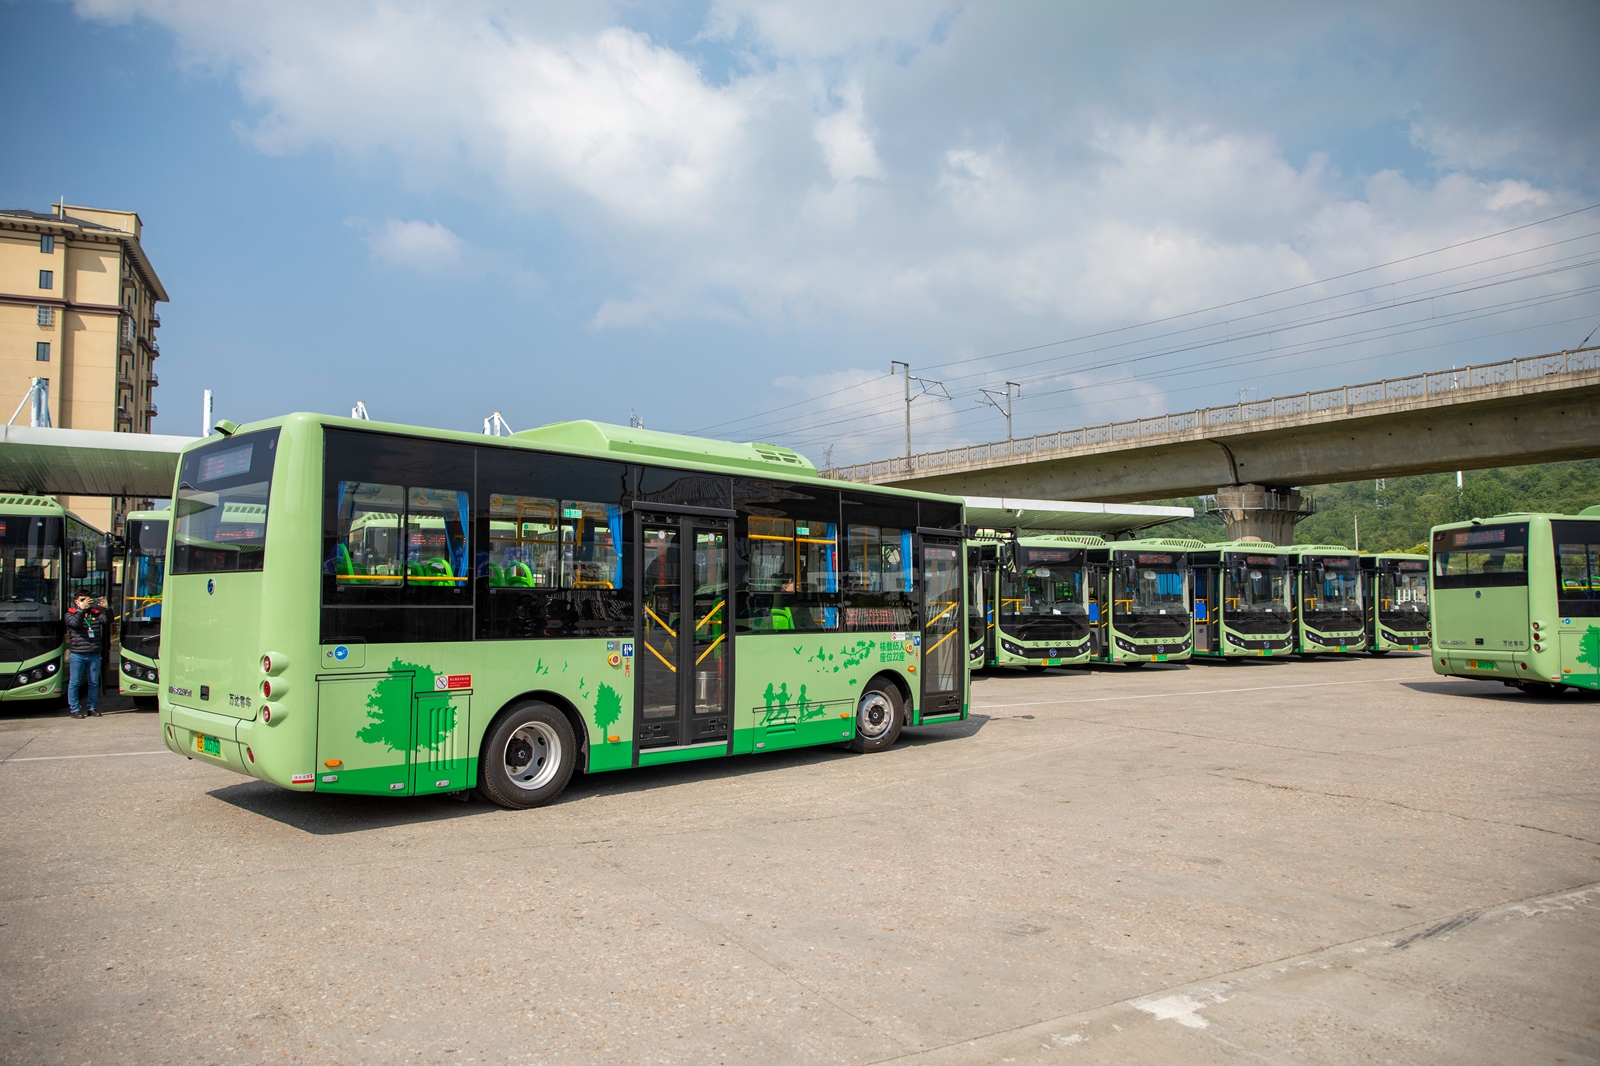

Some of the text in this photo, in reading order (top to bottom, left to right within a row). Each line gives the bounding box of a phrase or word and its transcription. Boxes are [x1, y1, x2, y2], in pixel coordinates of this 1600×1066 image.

[879, 641, 906, 652] 核载65人
[879, 652, 906, 662] 座位22座
